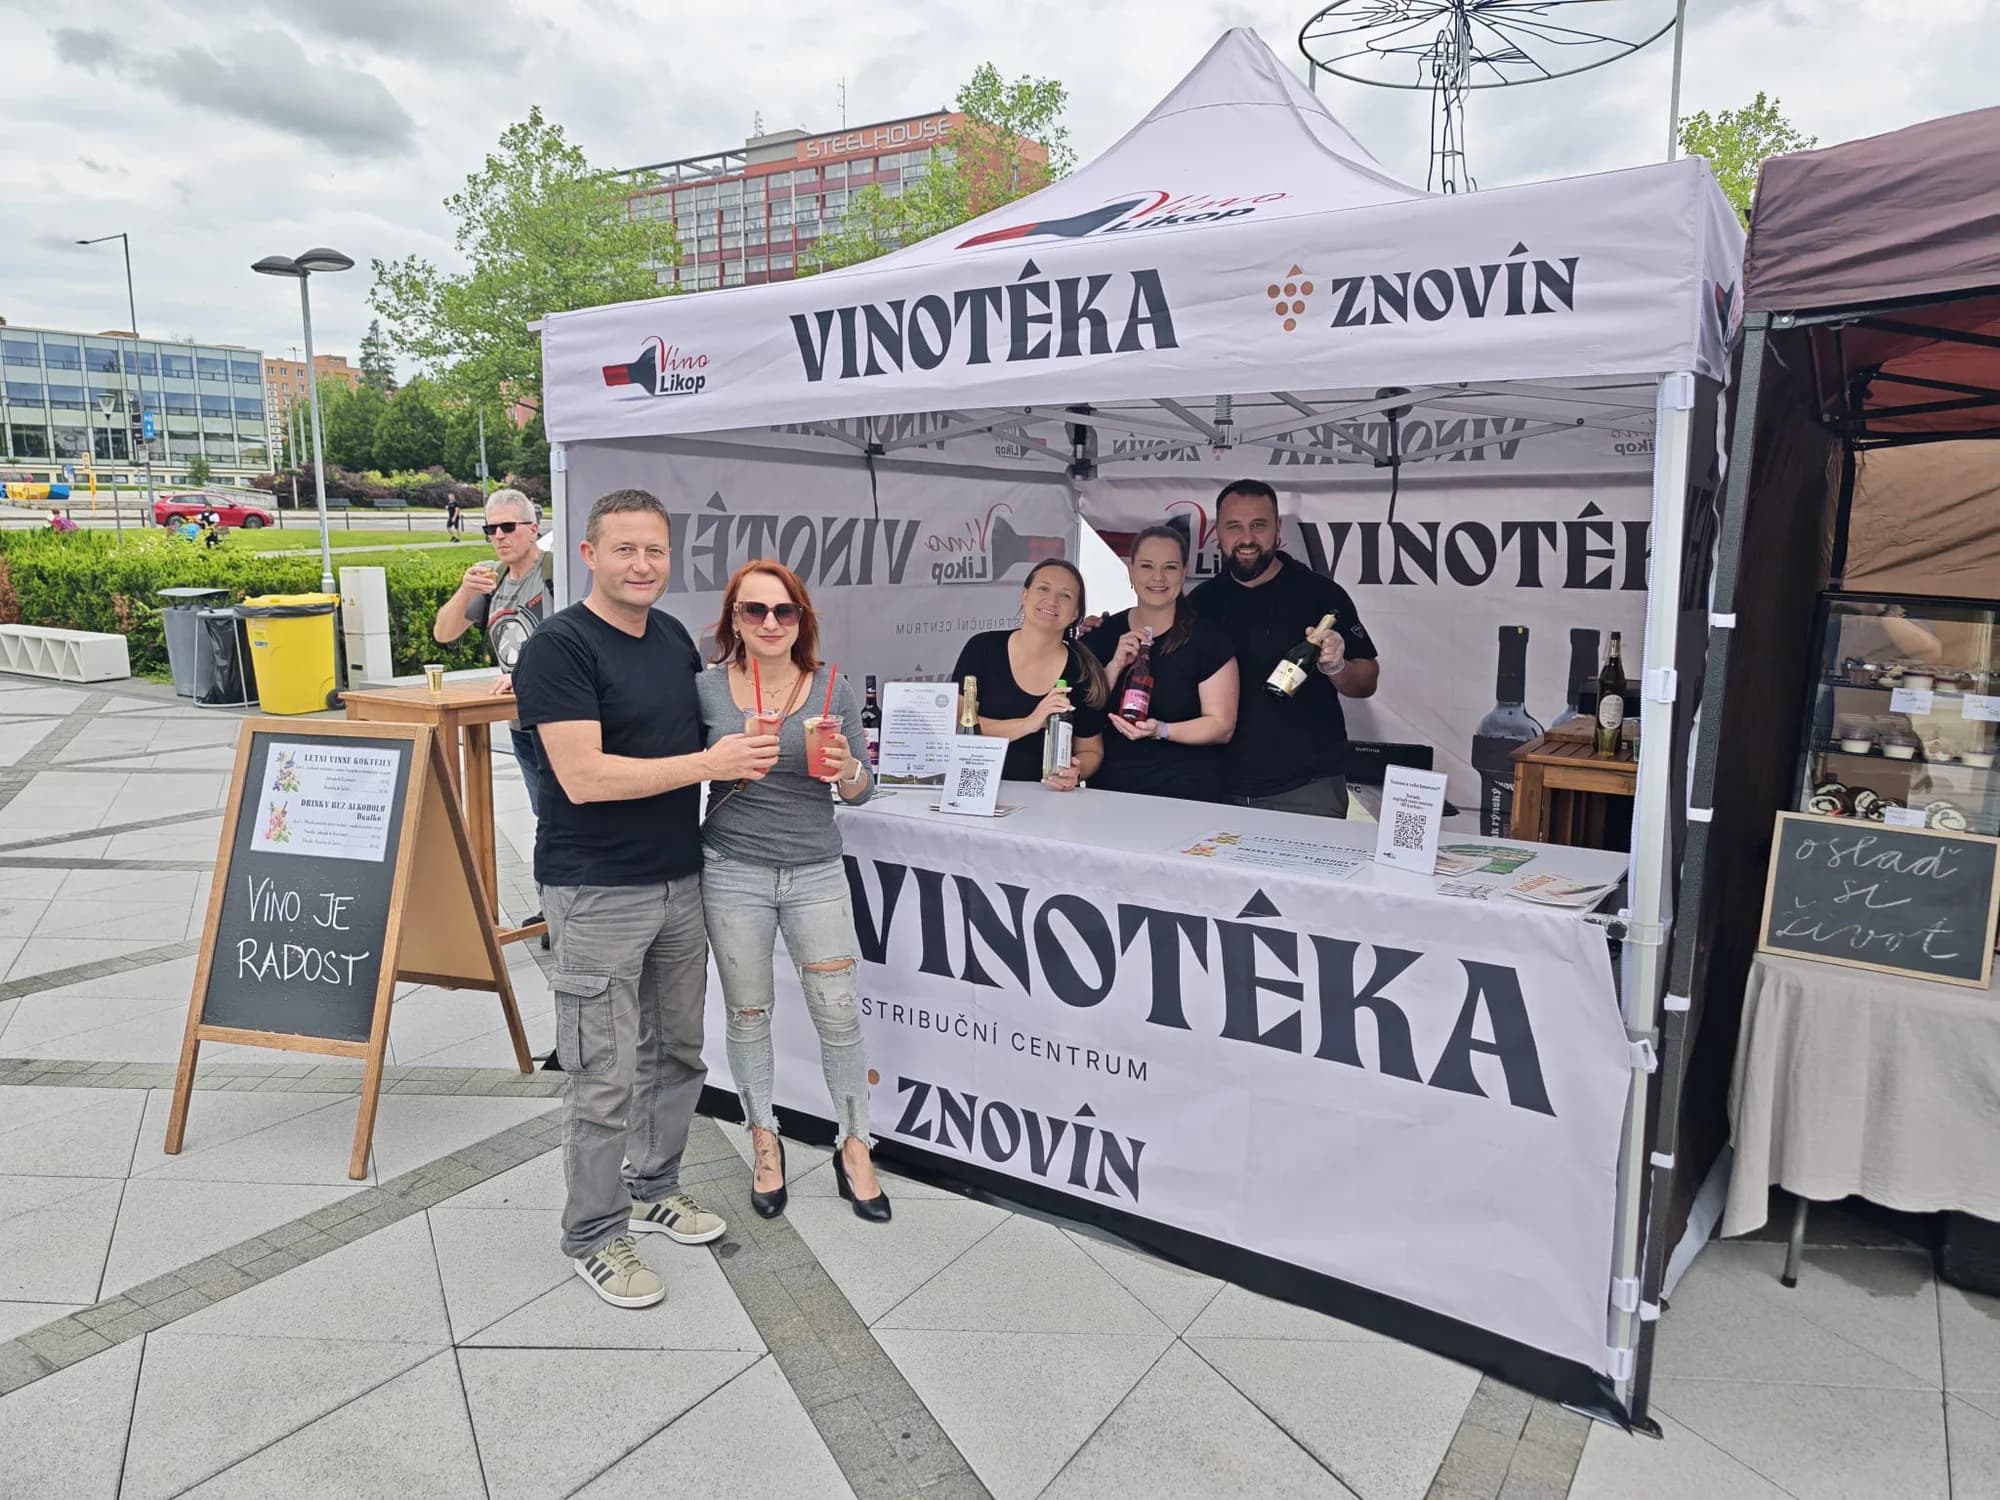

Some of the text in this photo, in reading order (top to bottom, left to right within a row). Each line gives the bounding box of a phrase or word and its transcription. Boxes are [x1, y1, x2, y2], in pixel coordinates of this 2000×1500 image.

[1102, 207, 1255, 232] Likop
[790, 258, 1179, 382] VINOTÉKA
[1331, 241, 1579, 328] ZNOVÍN
[660, 373, 706, 394] Likop
[1298, 501, 1652, 590] VINOTÉ
[313, 892, 354, 930] JE
[1834, 879, 1911, 909] si
[237, 938, 370, 985] RADOST
[842, 855, 1557, 1117] VINOTÉKA
[861, 995, 1149, 1082] STRIBUČNÍ CENTRUM
[894, 1077, 1148, 1204] ZNOVÍN
